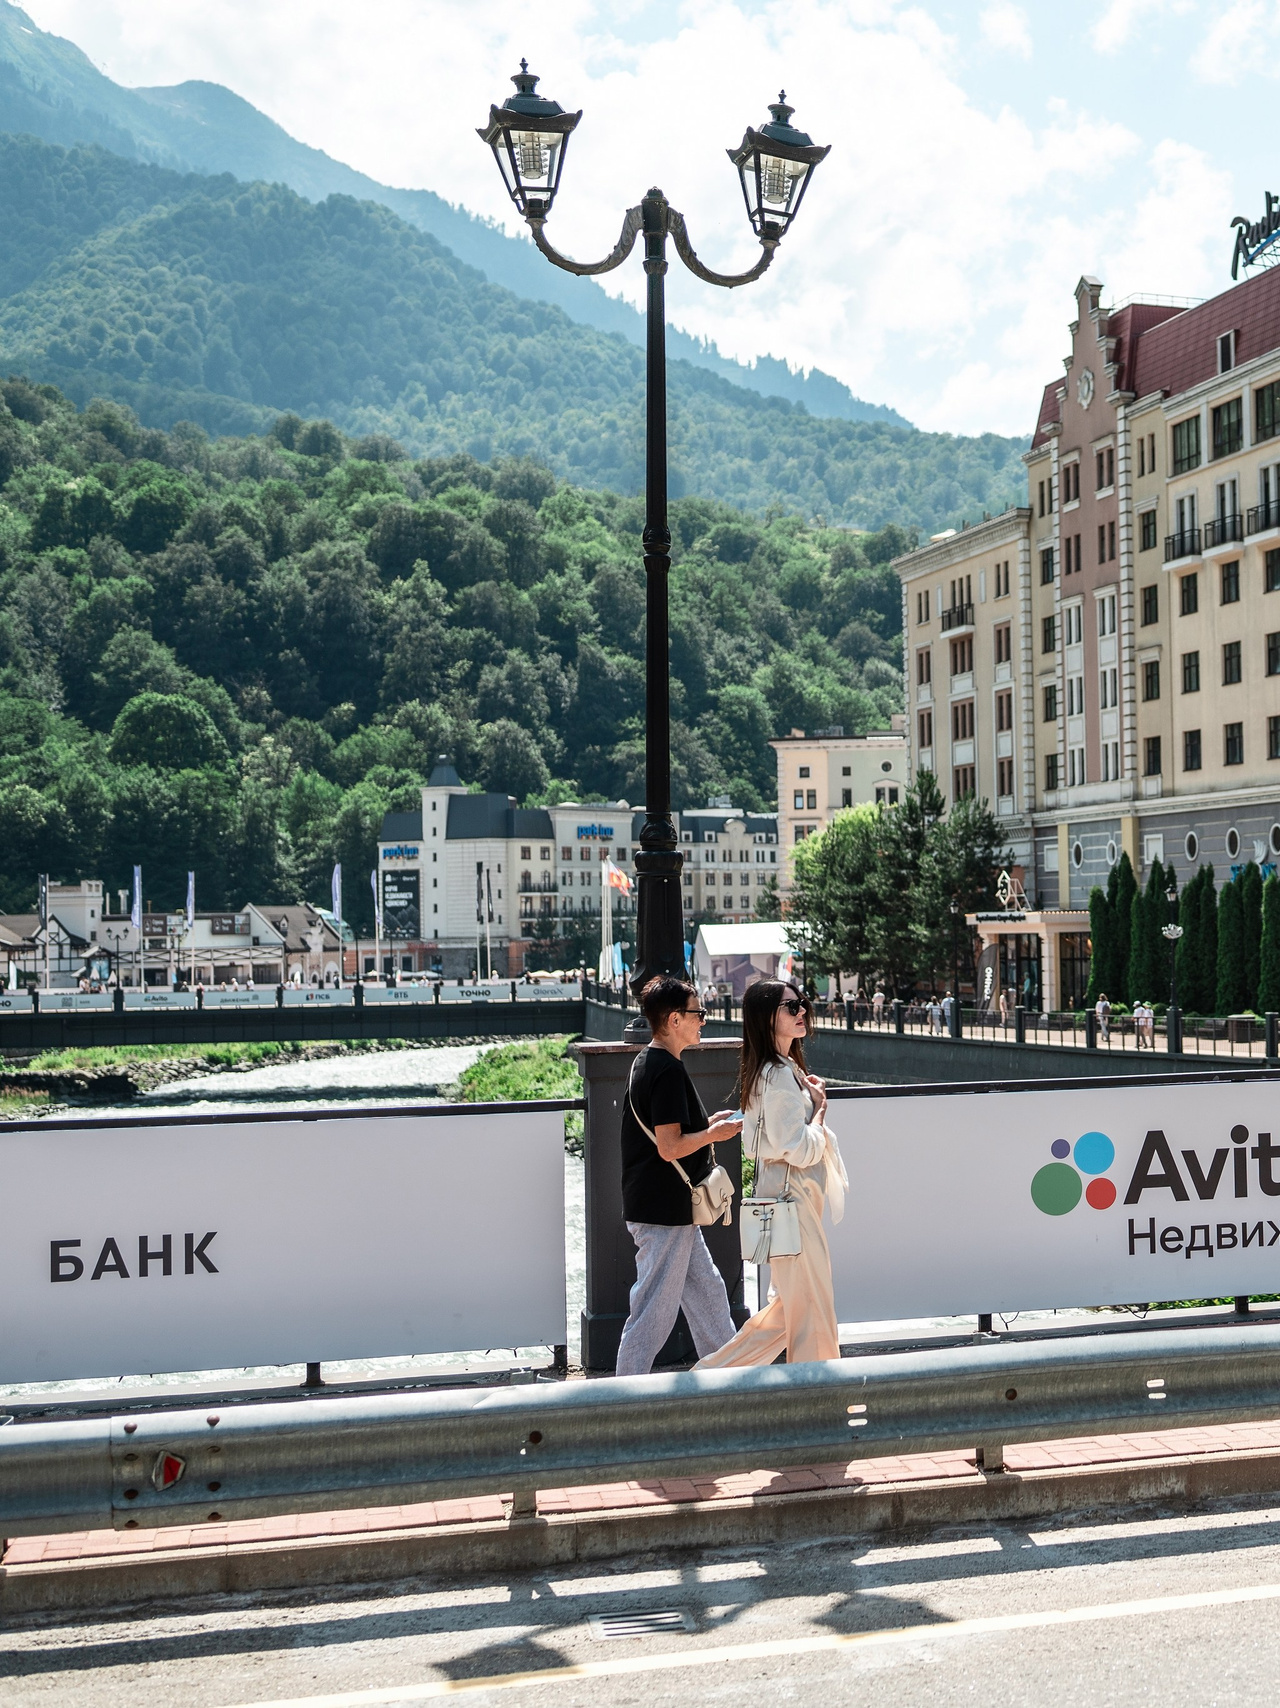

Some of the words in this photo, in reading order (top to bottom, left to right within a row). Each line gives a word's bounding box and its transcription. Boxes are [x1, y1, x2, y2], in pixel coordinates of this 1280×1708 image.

[459, 989, 491, 997] ТОЧНО
[984, 966, 993, 1001] ТОЧНО
[394, 991, 409, 999] ВТБ
[50, 1231, 220, 1283] БАНК
